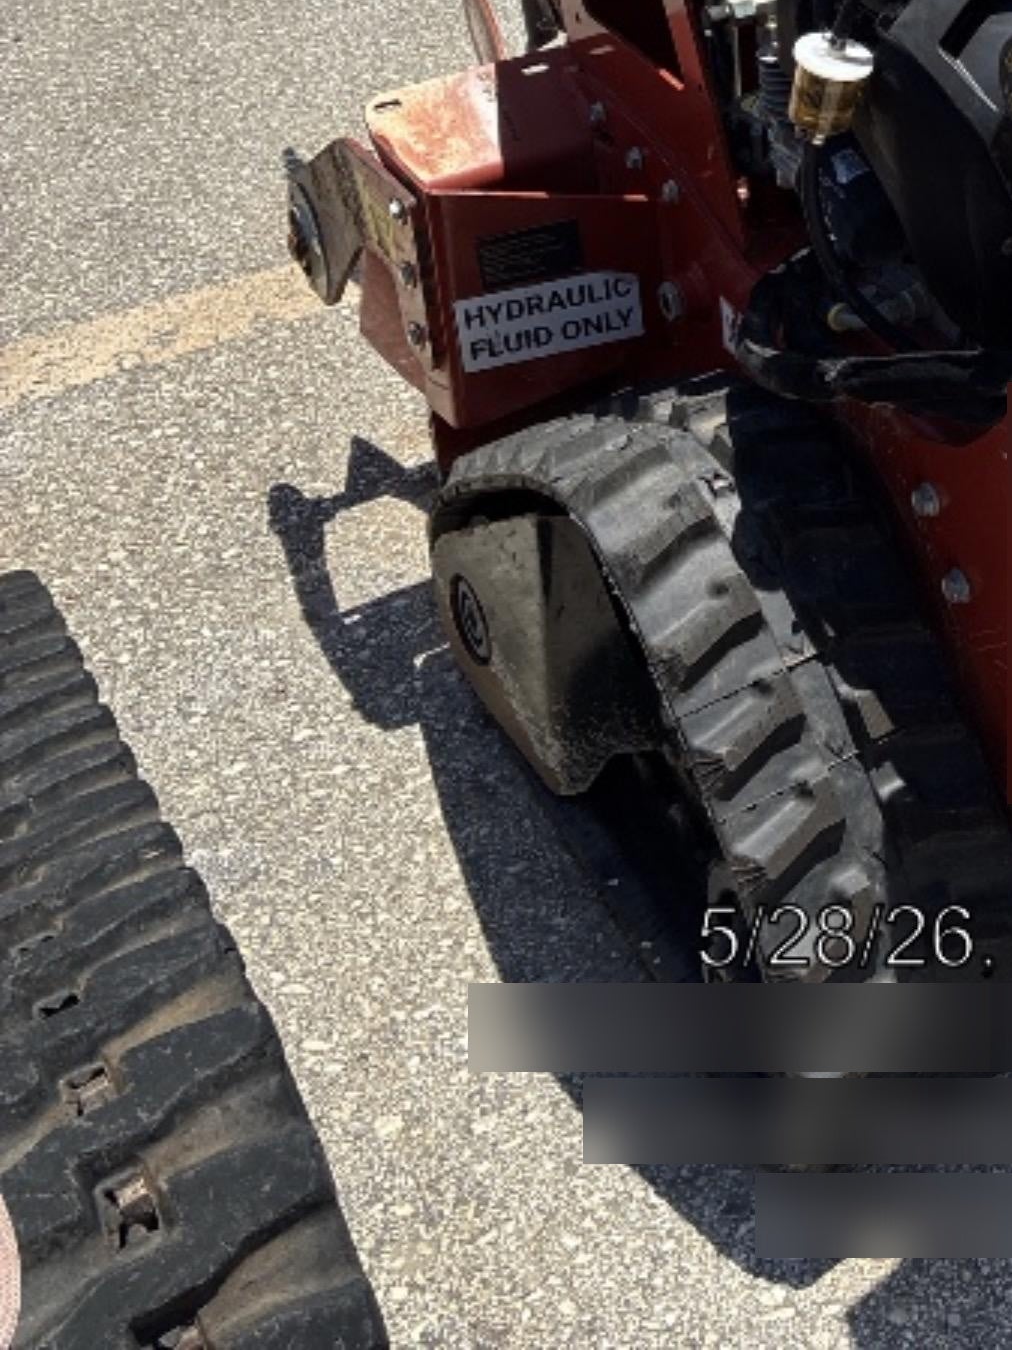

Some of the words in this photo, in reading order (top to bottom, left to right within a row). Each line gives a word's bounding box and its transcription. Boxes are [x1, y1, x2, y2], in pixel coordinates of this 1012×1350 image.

[462, 277, 633, 331] HYDRAULIC
[469, 325, 553, 361] FLUID
[560, 306, 635, 342] ONLY
